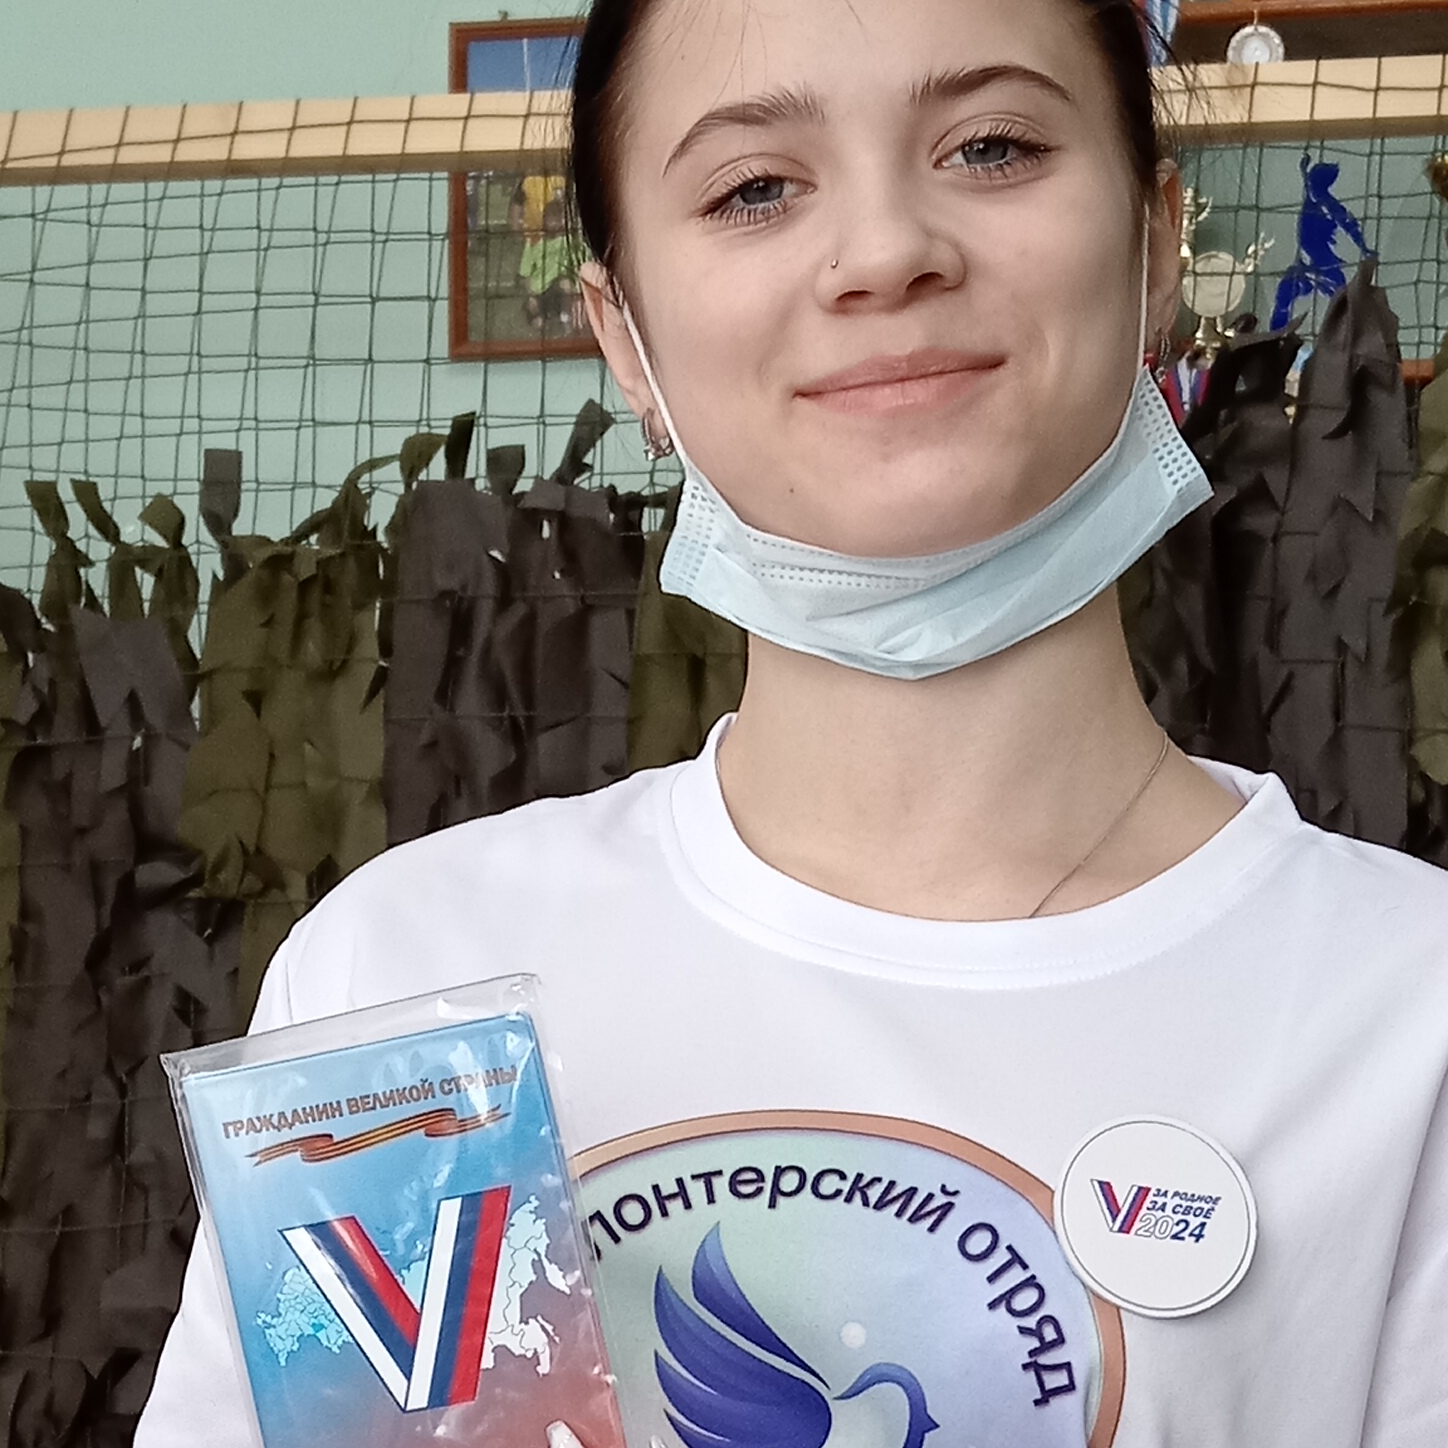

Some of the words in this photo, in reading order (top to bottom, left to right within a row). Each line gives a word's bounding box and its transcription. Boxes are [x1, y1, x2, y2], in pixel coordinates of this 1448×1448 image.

[222, 1100, 344, 1139] ГРАЖДАНИН
[346, 1078, 436, 1115] ВЕЛИКОЙ
[1146, 1200, 1166, 1214] ЗА
[1171, 1204, 1216, 1219] СВОЁ
[1152, 1188, 1169, 1200] ЗА
[1171, 1190, 1222, 1205] РОДНОЕ
[1135, 1213, 1208, 1243] 2024
[956, 1221, 1077, 1408] отряд
